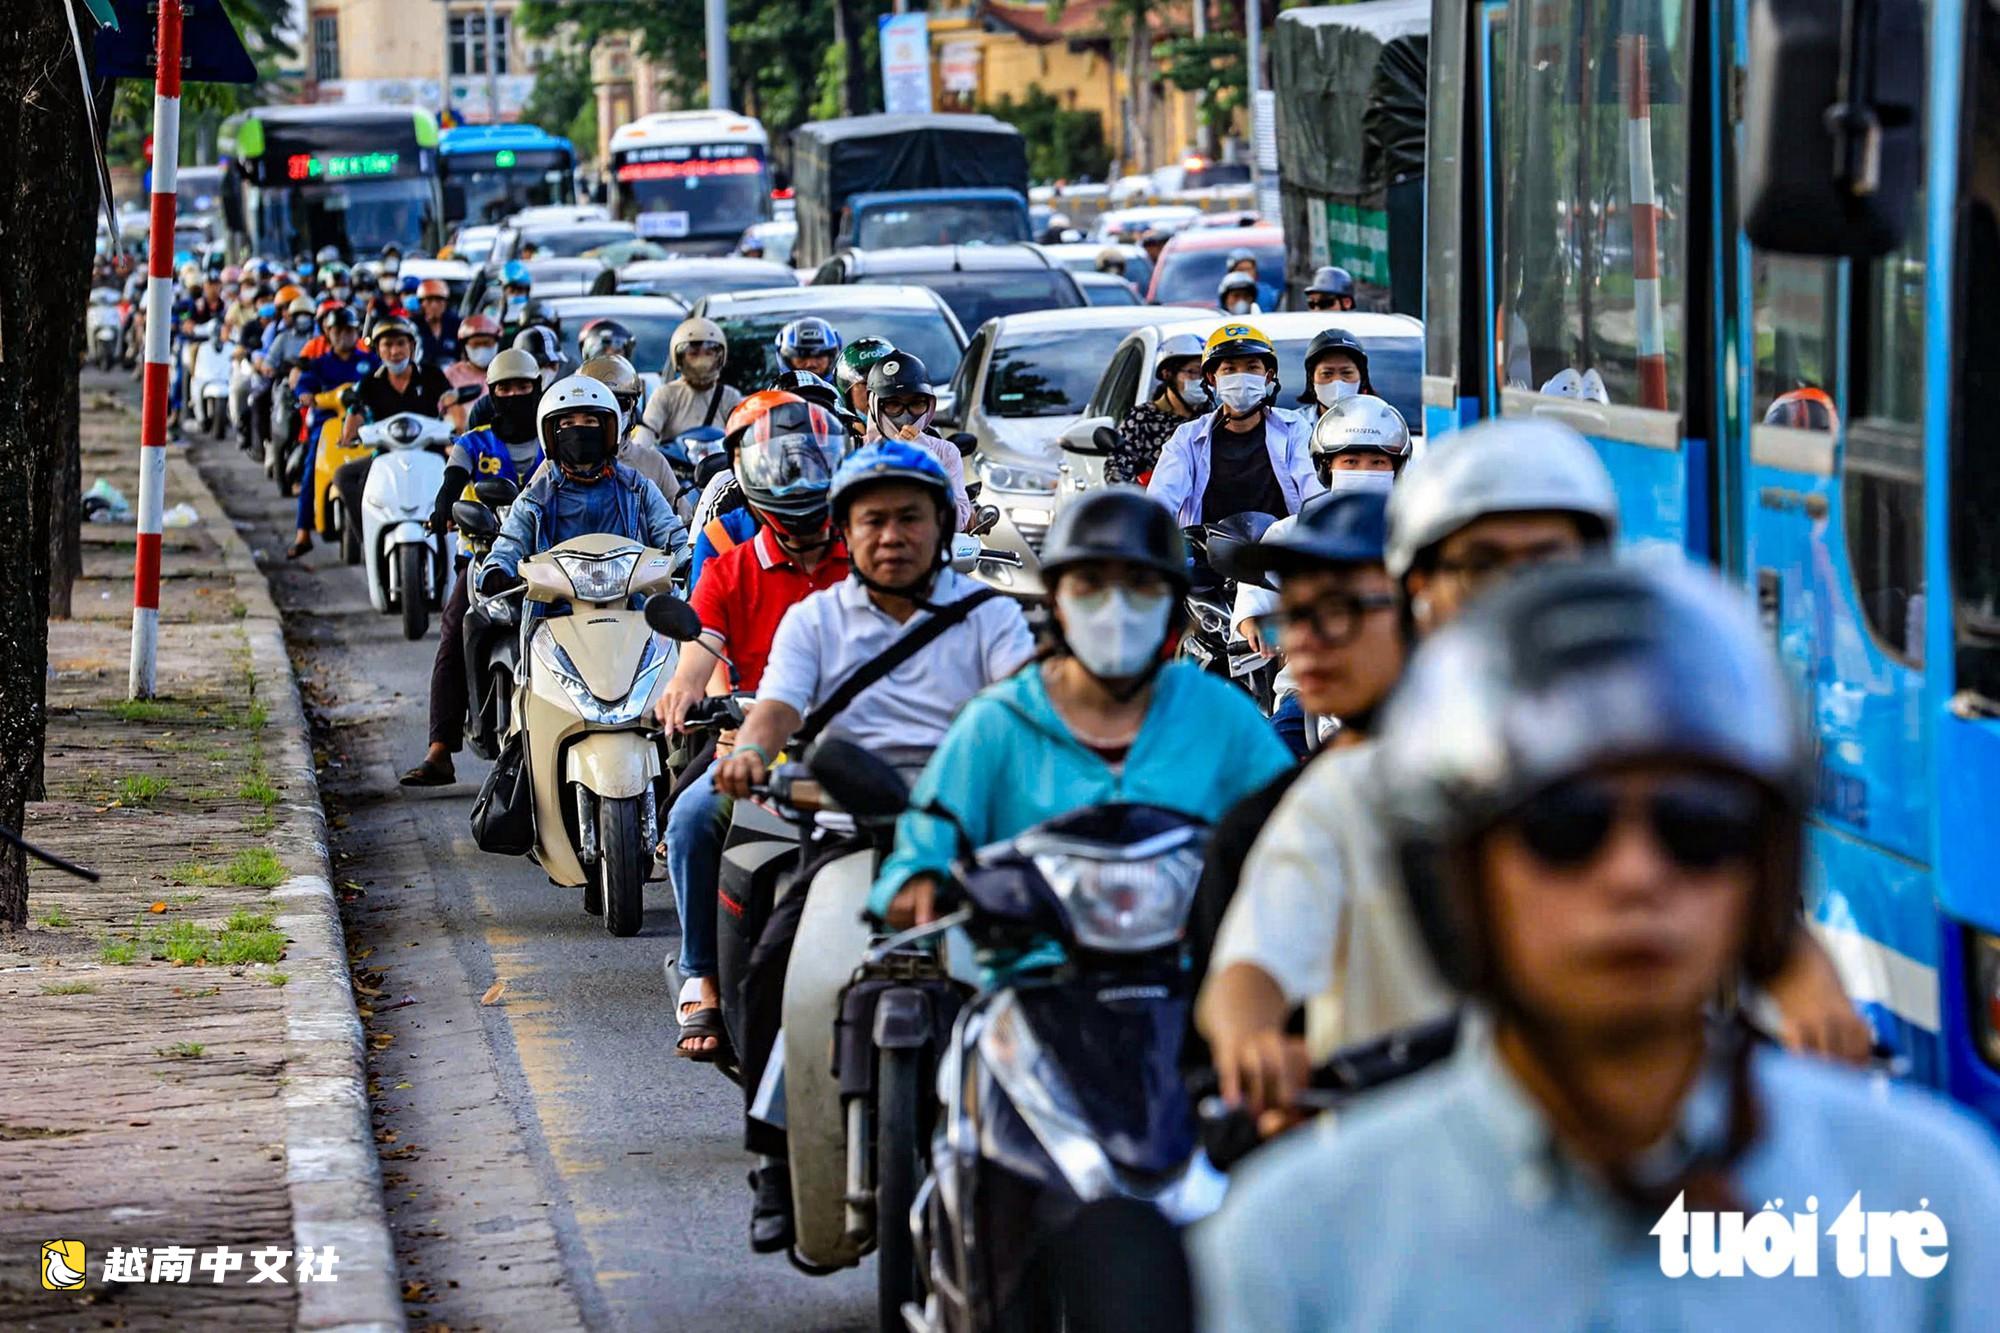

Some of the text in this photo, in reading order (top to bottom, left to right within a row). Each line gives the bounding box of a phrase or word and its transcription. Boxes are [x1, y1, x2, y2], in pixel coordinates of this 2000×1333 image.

[1225, 327, 1249, 337] be
[859, 349, 885, 360] Grab
[1345, 427, 1381, 435] HONDA
[478, 450, 502, 475] be
